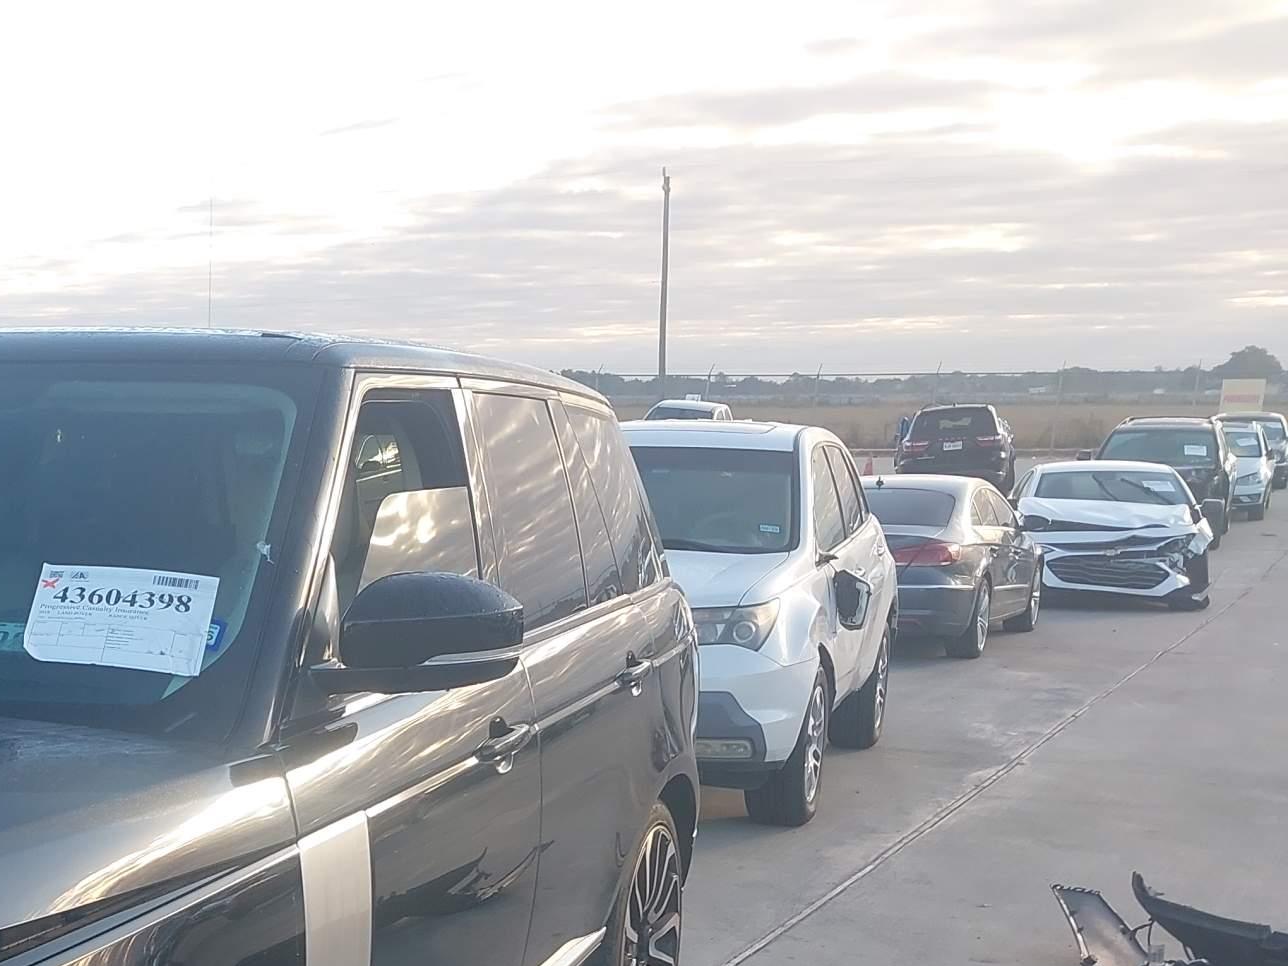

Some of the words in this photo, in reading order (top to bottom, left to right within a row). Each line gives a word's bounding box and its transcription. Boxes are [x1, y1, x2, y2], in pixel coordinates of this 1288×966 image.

[40, 603, 81, 612] Progressive
[82, 605, 113, 613] Casualty
[115, 607, 149, 615] Insurance
[53, 586, 193, 613] 43604398
